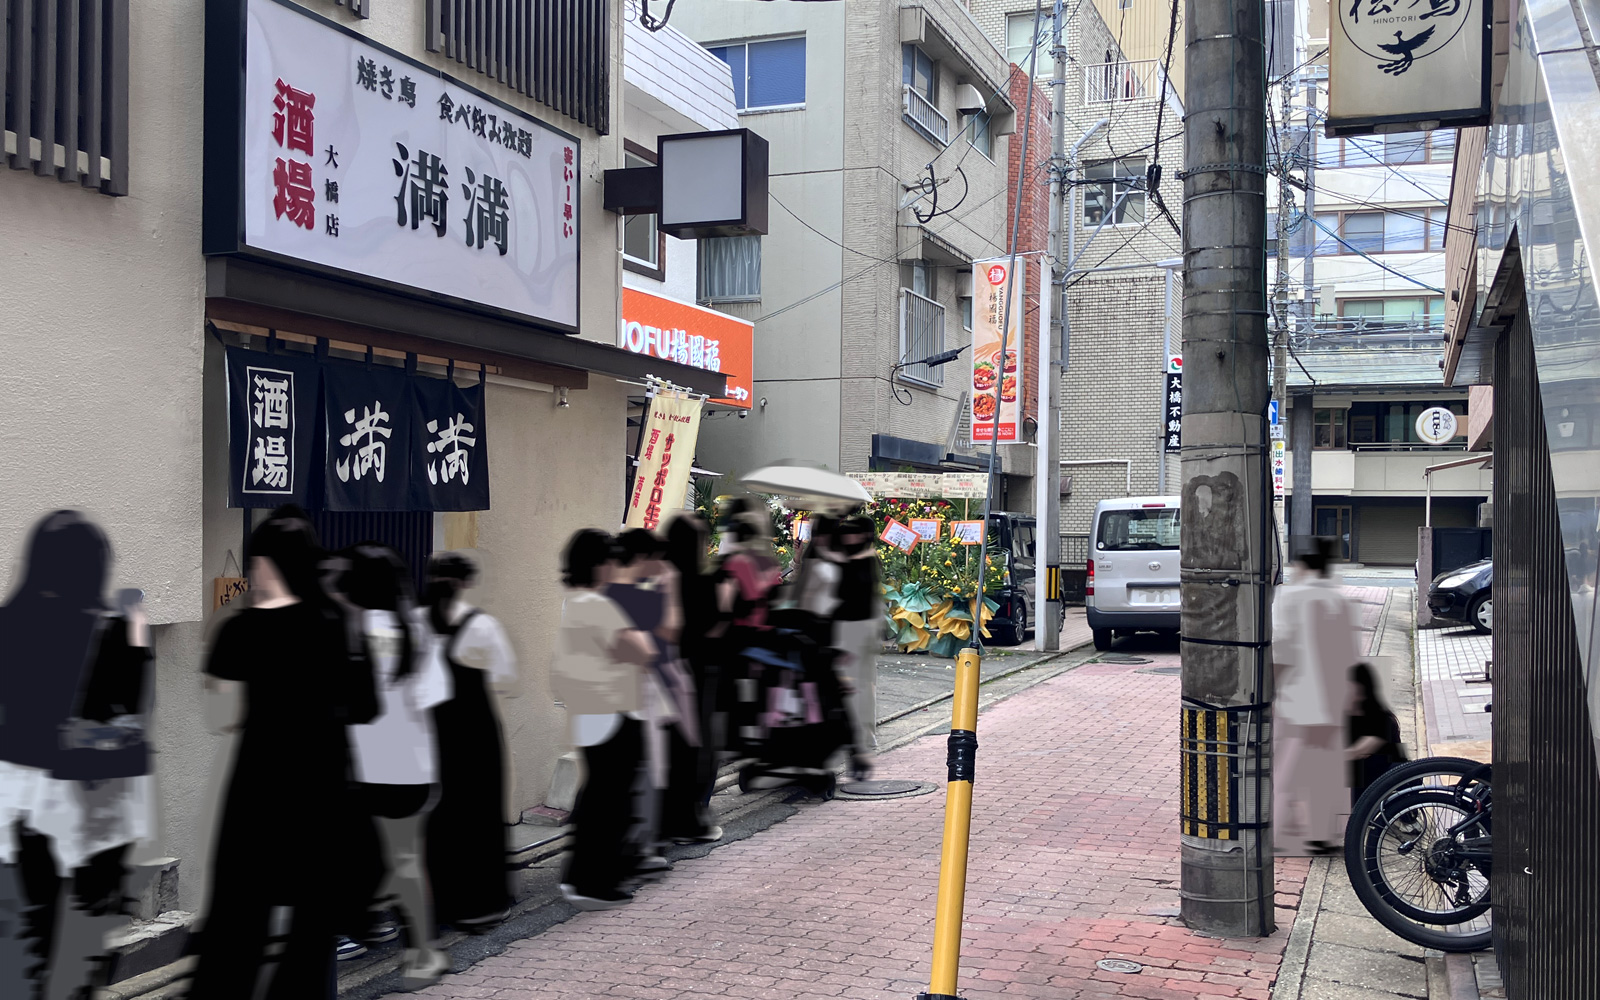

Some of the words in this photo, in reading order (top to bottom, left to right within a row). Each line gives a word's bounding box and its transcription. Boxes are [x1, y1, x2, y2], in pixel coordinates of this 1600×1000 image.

[1373, 16, 1417, 24] HINOTORI
[271, 78, 316, 230] 酒場
[356, 55, 416, 108] 焼き鳥
[437, 92, 533, 159] 食べ飲み放題
[324, 145, 340, 238] 大橋店
[392, 141, 511, 256] 満満
[252, 374, 289, 488] 酒場
[1167, 376, 1182, 447] 大橋不動産
